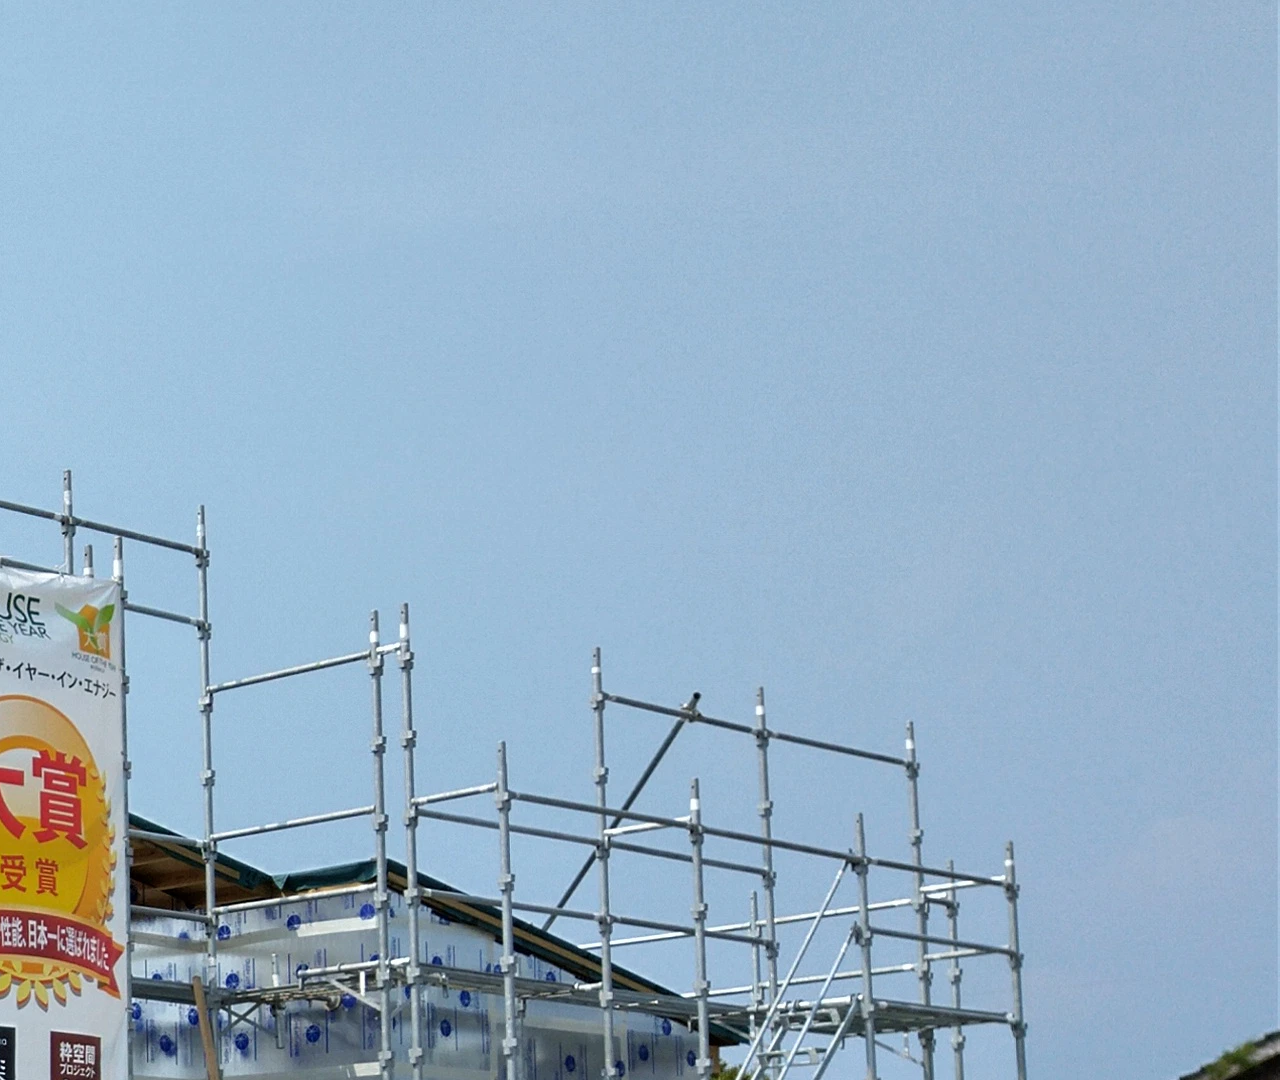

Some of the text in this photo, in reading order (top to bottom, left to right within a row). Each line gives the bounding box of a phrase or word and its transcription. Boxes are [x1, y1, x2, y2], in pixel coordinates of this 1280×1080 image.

[9, 619, 51, 641] YEAR
[0, 854, 59, 897] 受賞
[59, 1041, 96, 1065] 粋空間
[59, 1063, 96, 1078] プロジェクト
